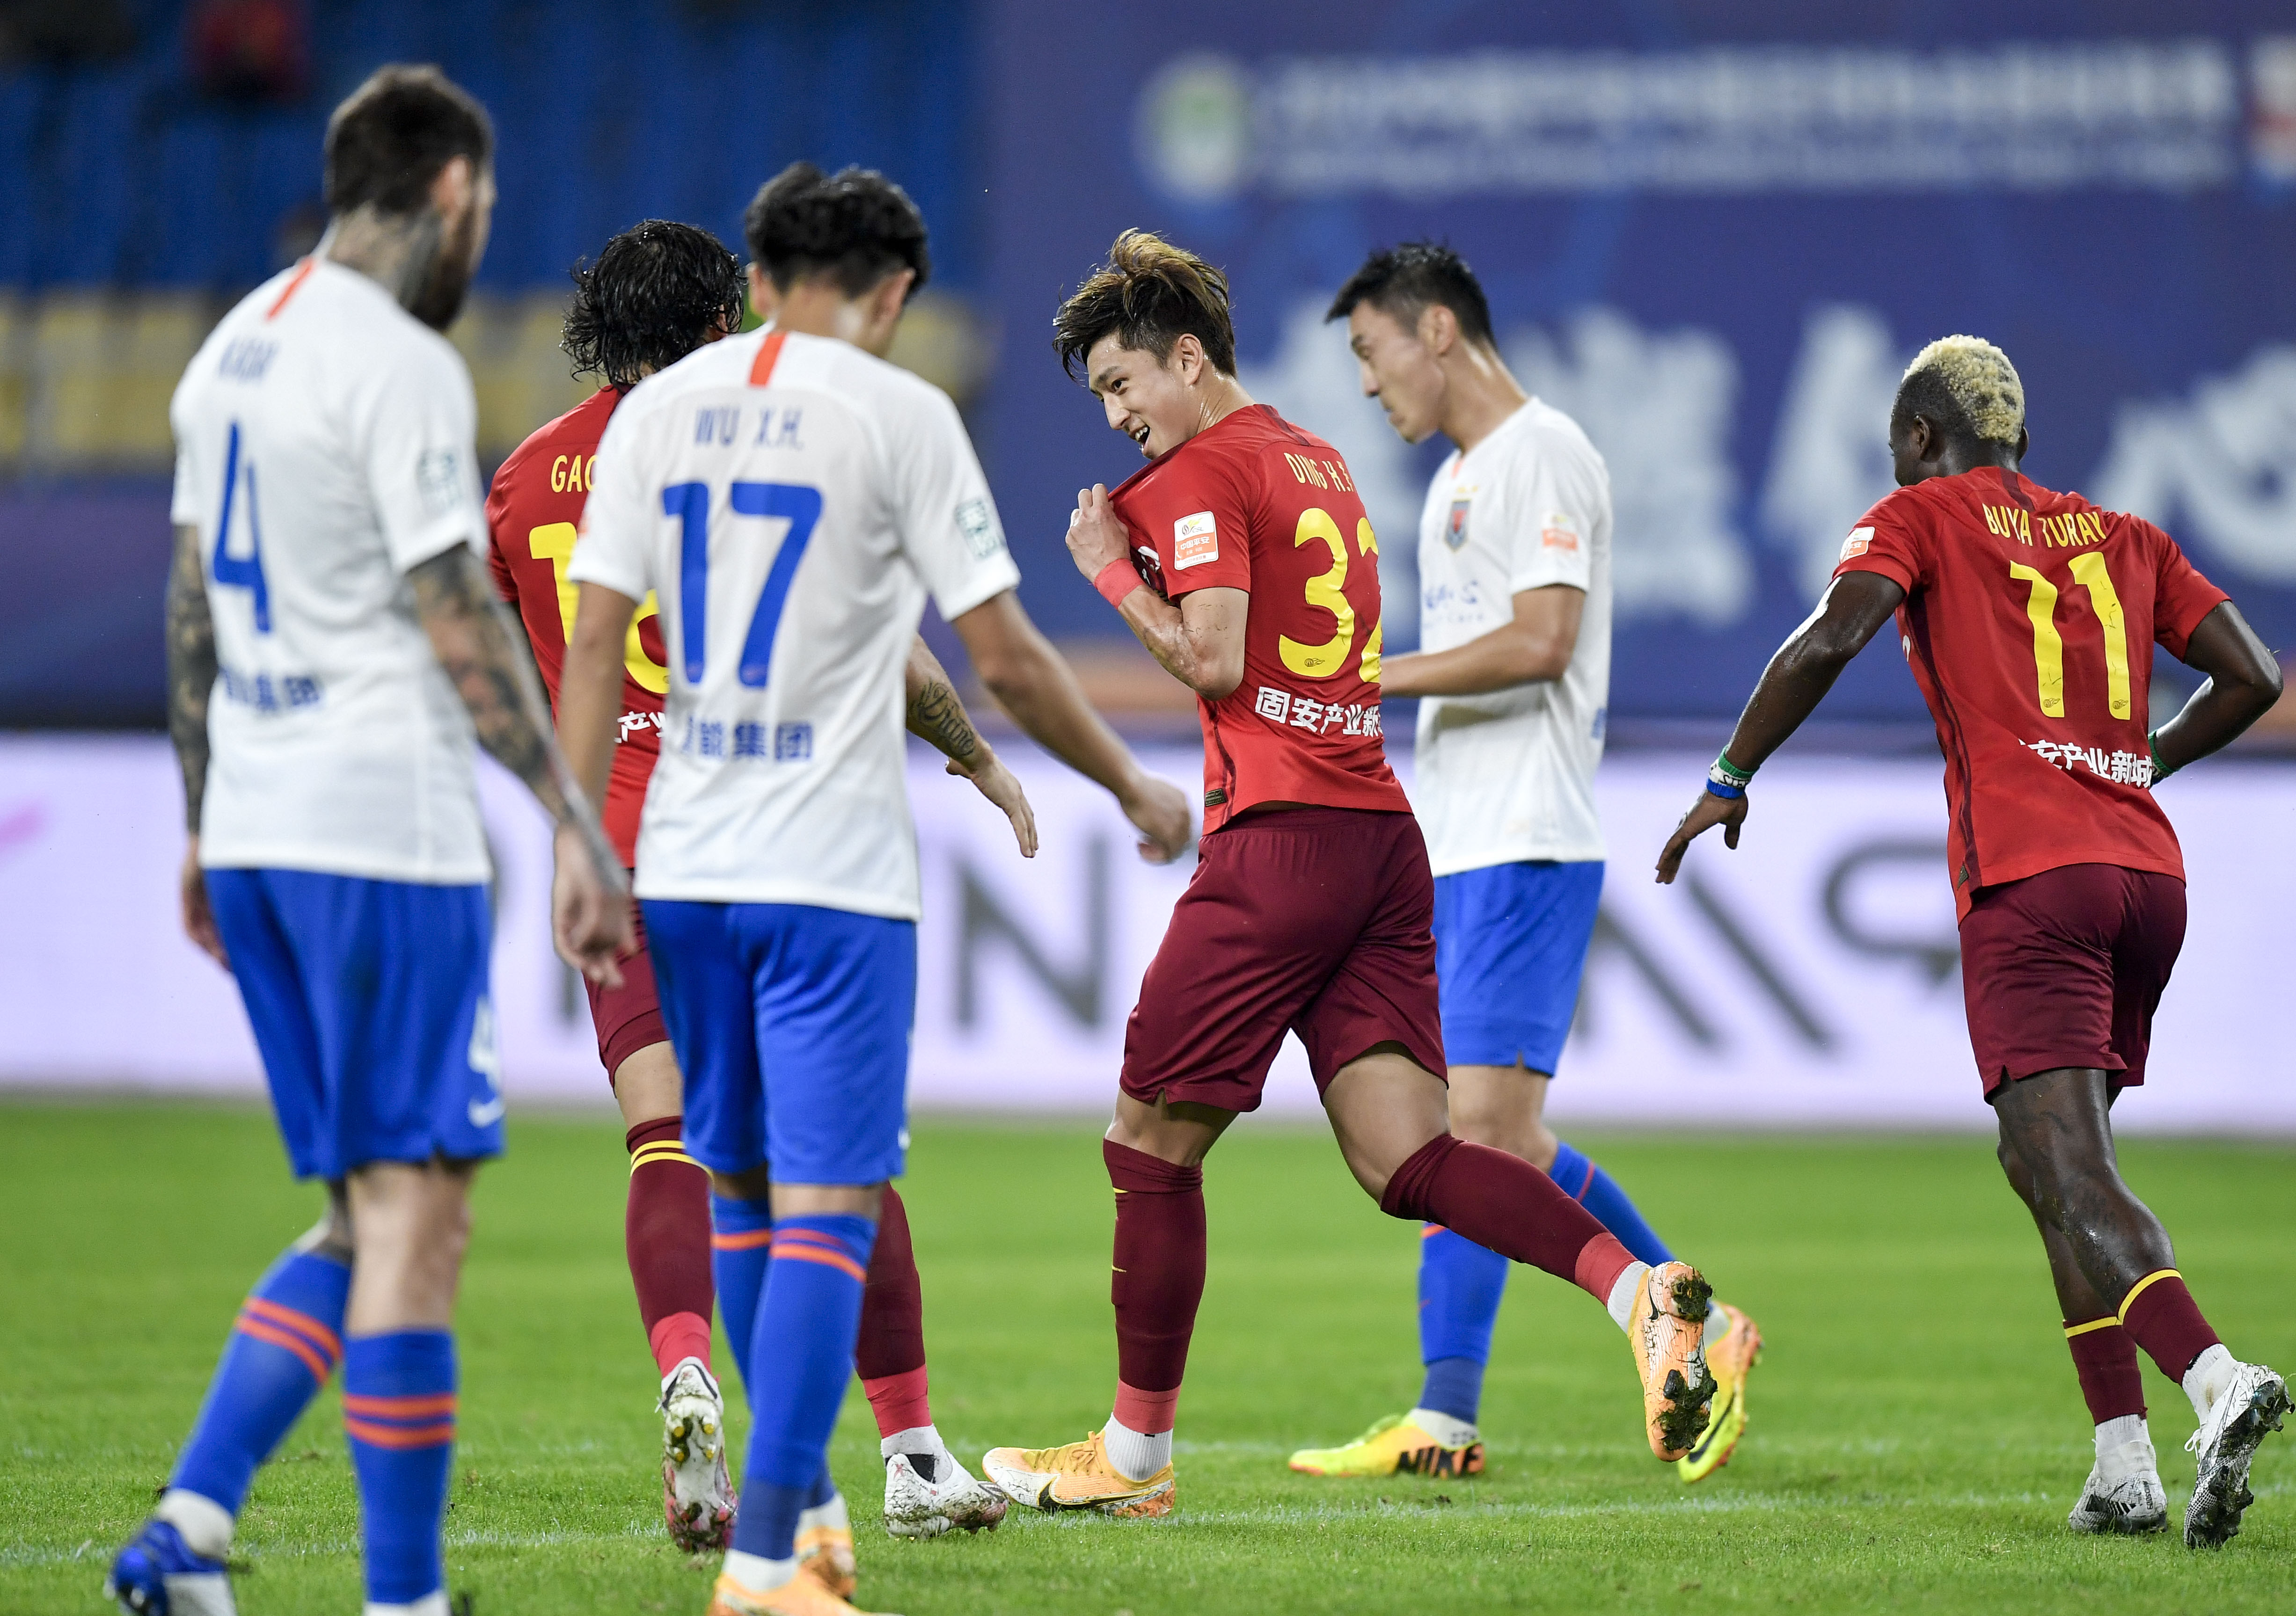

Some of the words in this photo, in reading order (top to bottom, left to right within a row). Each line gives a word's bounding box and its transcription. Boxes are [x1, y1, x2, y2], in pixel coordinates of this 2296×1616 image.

[694, 407, 740, 446] WU
[1284, 452, 1328, 490] DING
[212, 418, 272, 635] 4
[1982, 502, 2033, 546] BUYA
[2037, 511, 2106, 548] TURAY
[661, 480, 823, 689] 17
[2009, 551, 2131, 721] 11
[1255, 685, 1383, 738] 固安产业新
